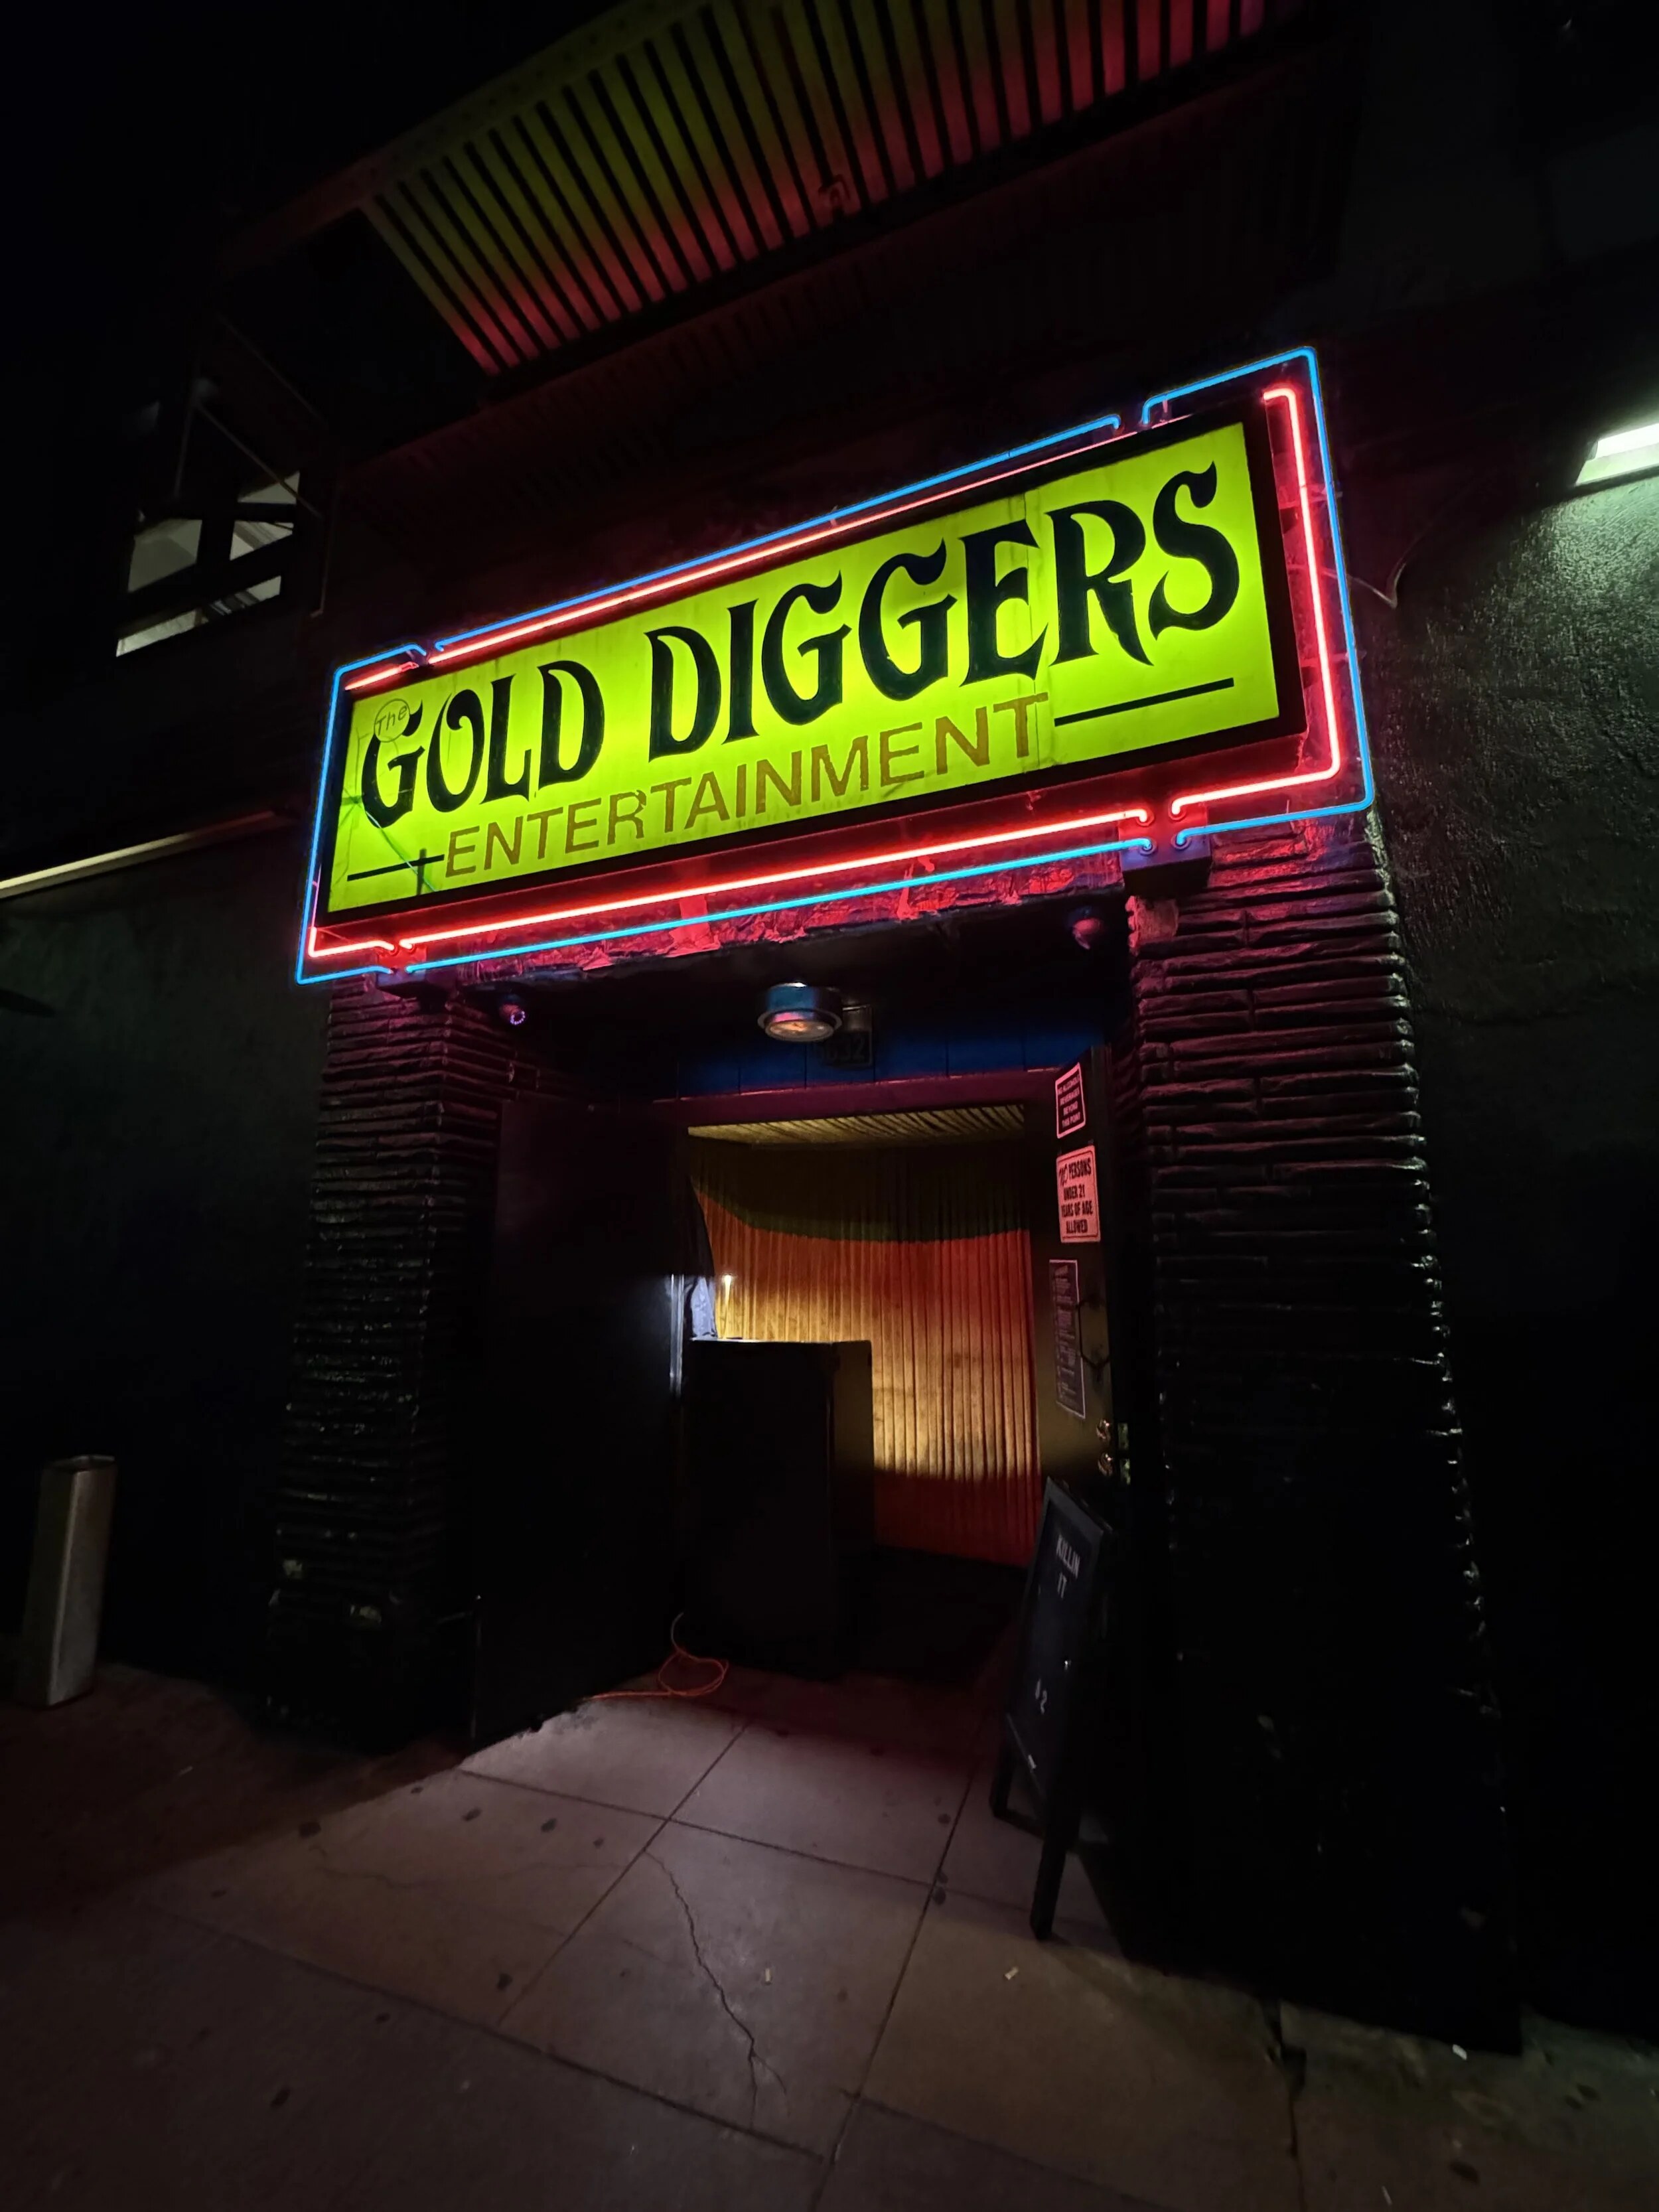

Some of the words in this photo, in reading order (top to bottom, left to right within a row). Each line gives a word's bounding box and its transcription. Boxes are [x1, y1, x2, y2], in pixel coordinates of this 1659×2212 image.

[361, 659, 604, 830] GOLD
[646, 461, 1240, 757] DIGGERS
[375, 705, 407, 736] The
[443, 692, 1050, 879] ENTERTAINMENT
[1068, 1157, 1092, 1179] PERSONS
[1064, 1185, 1078, 1201] UNDER
[1078, 1183, 1085, 1199] 21
[1061, 1203, 1074, 1217] YEARS
[1074, 1201, 1081, 1216] OF
[1082, 1200, 1093, 1215] AGE
[1066, 1218, 1088, 1234] ALLOWED
